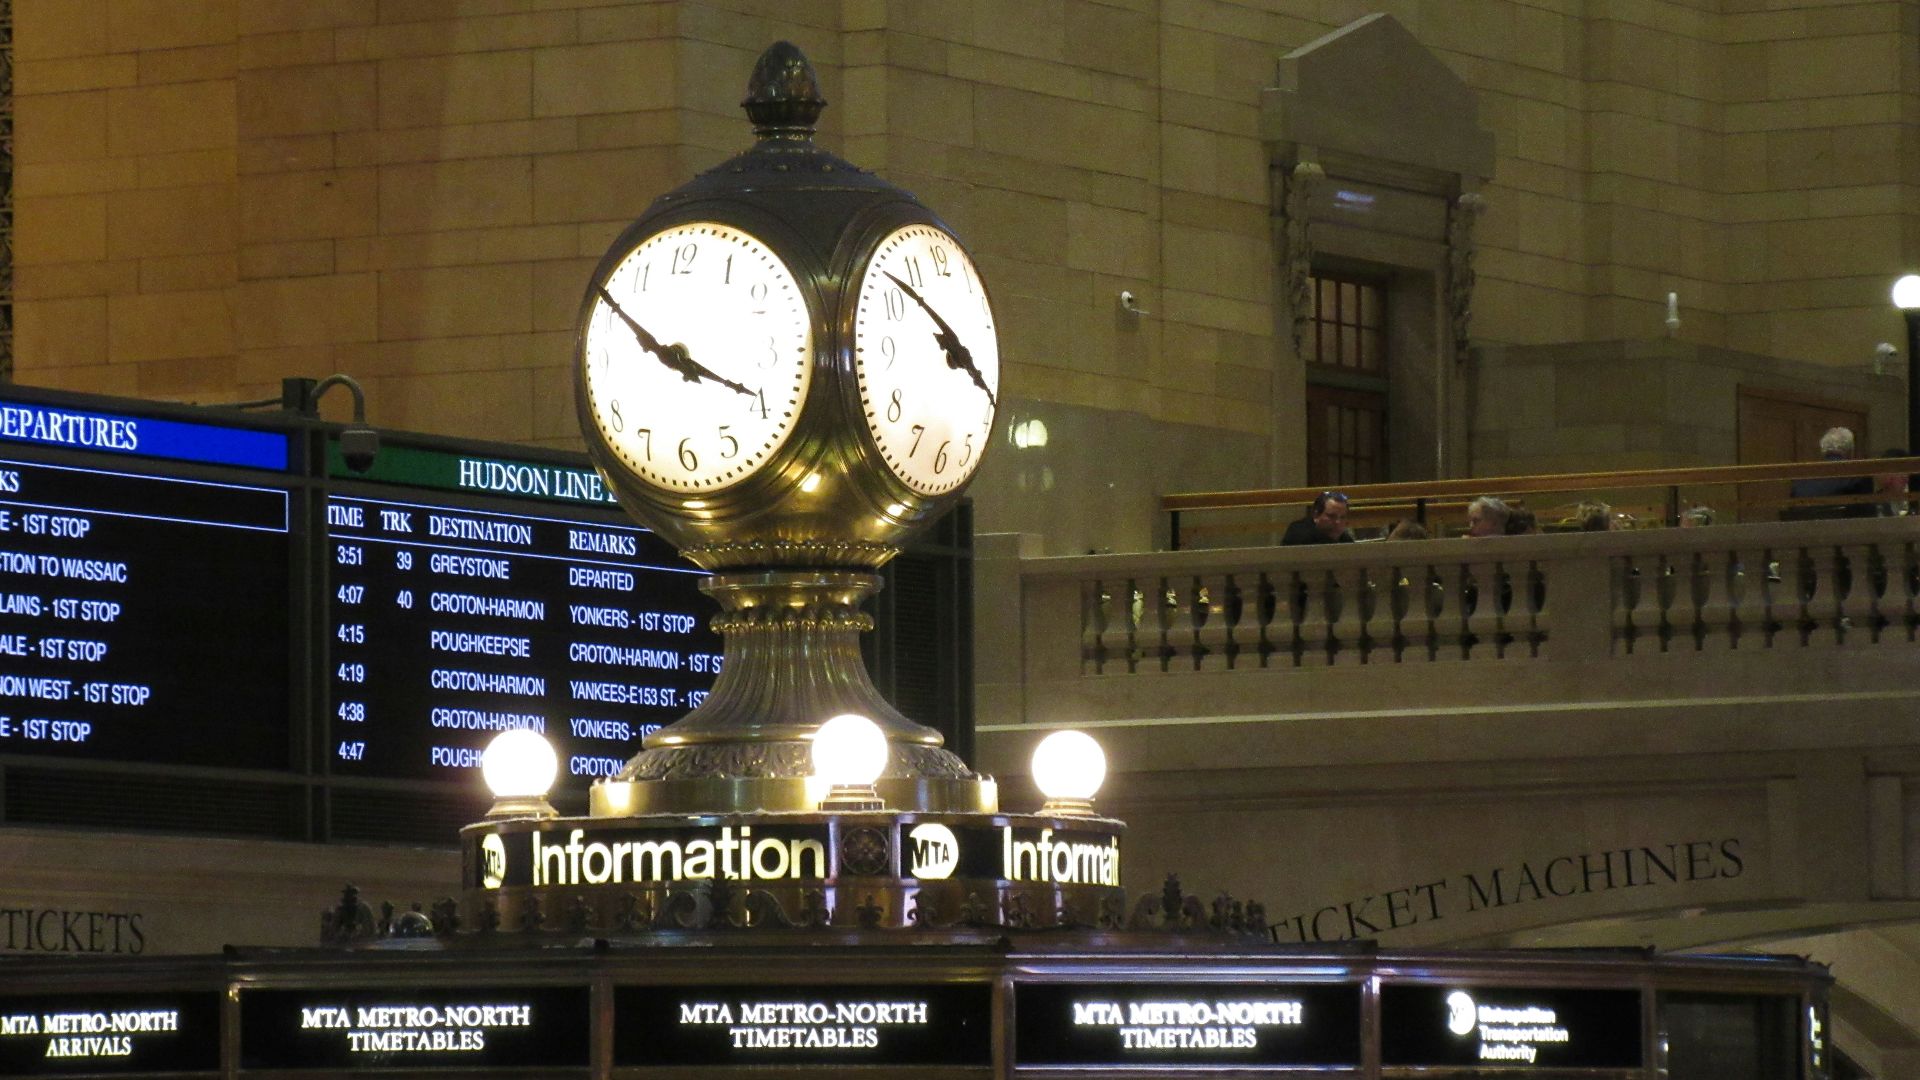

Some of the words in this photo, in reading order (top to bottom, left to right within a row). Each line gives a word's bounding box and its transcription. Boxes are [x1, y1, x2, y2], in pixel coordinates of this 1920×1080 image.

[671, 243, 698, 275] 12
[905, 256, 923, 288] 11
[929, 245, 951, 277] 12
[633, 262, 651, 293] 11
[883, 287, 904, 322] 10
[611, 399, 624, 433] 8
[749, 387, 771, 420] 4
[887, 388, 902, 423] 8
[637, 428, 651, 462] 7
[678, 437, 698, 472] 6
[719, 425, 738, 459] 5
[911, 424, 925, 458] 7
[959, 433, 973, 467] 5
[934, 440, 951, 475] 6
[459, 459, 549, 496] HUDSON
[554, 470, 603, 501] LINE
[22, 513, 48, 534] 1ST
[51, 516, 90, 538] STOP
[380, 510, 412, 533] TRK
[429, 515, 532, 545] DESTINATION
[569, 530, 636, 556] REMARKS
[0, 552, 36, 576] TION
[38, 556, 59, 577] TO
[61, 558, 127, 583] WASSAIC
[337, 545, 362, 566] 3:51
[396, 551, 412, 571] 39
[430, 554, 509, 580] GREYSTONE
[569, 568, 634, 591] DEPARTED
[52, 599, 78, 620] 1ST
[81, 601, 120, 622] STOP
[338, 585, 364, 604] 4:07
[397, 591, 413, 609] 40
[431, 593, 544, 621] CROTON-HARMON
[569, 605, 629, 629] YONKERS
[639, 613, 660, 631] 1ST
[662, 616, 695, 634] STOP
[38, 638, 65, 659] 1ST
[68, 640, 107, 662] STOP
[338, 624, 364, 644] 4:15
[431, 631, 530, 657] POUGHKEEPSIE
[569, 643, 679, 670] CROTON-HARMON
[688, 654, 710, 673] 1ST
[712, 656, 724, 674] S
[28, 678, 71, 700] WEST
[83, 683, 109, 703] 1ST
[111, 685, 150, 706] STOP
[338, 663, 364, 683] 4:19
[431, 670, 545, 697] CROTON-HARMON
[570, 681, 657, 706] YANKEES-E153
[660, 689, 677, 707] ST.
[22, 719, 48, 739] 1ST
[51, 721, 91, 742] STOP
[338, 702, 365, 722] 4:38
[570, 718, 630, 741] YONKERS
[339, 742, 365, 760] 4:47
[533, 826, 826, 887] Information
[1464, 838, 1743, 913] MACHINES
[1, 909, 144, 954] TICKETS
[1, 1015, 39, 1034] MTA
[43, 1011, 178, 1033] METRO-NORTH
[301, 1008, 351, 1029] MTA
[357, 1005, 531, 1028] METRO-NORTH
[680, 1003, 734, 1024] MTA
[740, 1002, 928, 1024] METRO-NORTH
[1073, 1002, 1124, 1025] MTA
[1129, 1002, 1303, 1025] METRO-NORTH
[46, 1036, 131, 1057] ARRIVALS
[347, 1030, 485, 1052] TIMETABLES
[730, 1027, 879, 1048] TIMETABLES
[1119, 1027, 1257, 1049] TIMETABLES
[1479, 1043, 1537, 1063] Authority
